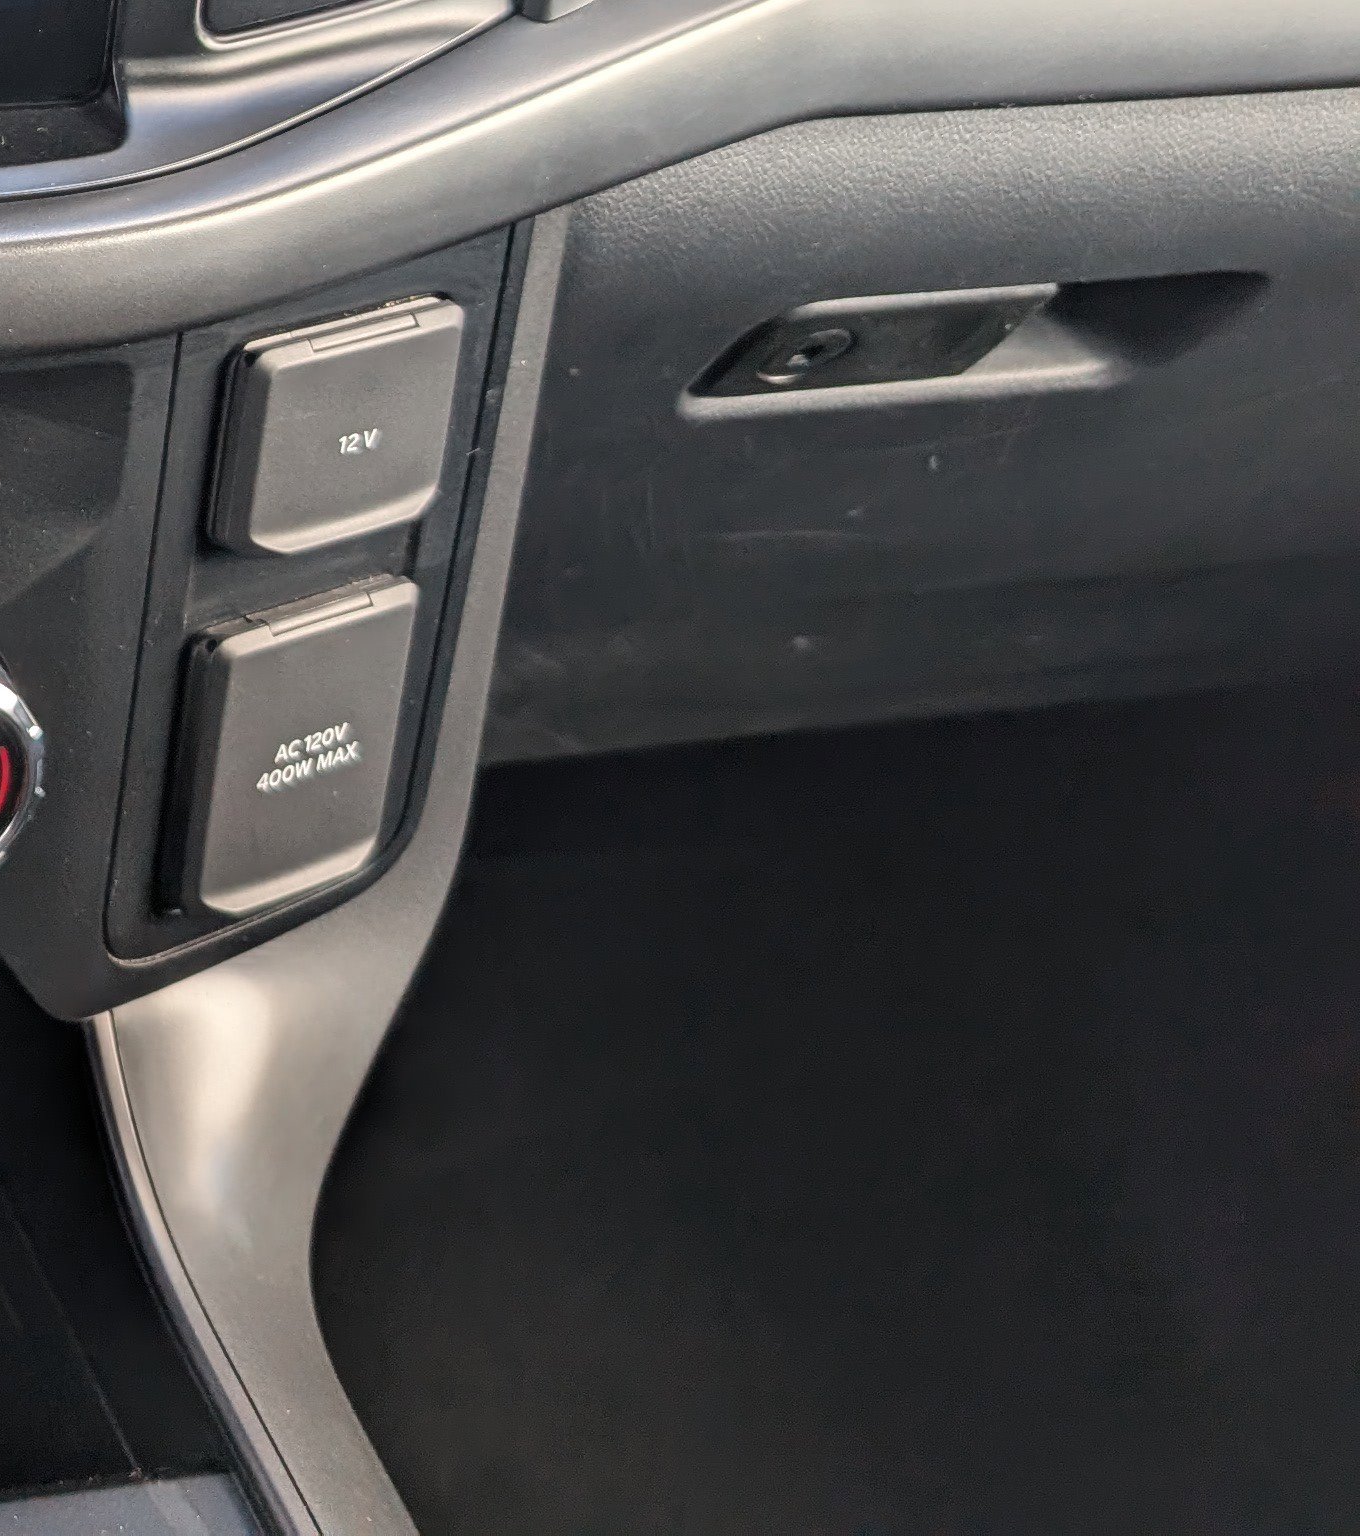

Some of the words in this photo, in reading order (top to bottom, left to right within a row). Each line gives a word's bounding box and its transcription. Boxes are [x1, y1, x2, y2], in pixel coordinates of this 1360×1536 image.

[256, 757, 314, 793] 400W
[316, 740, 360, 774] MAX
[274, 739, 304, 764] AC
[303, 722, 350, 754] 120V
